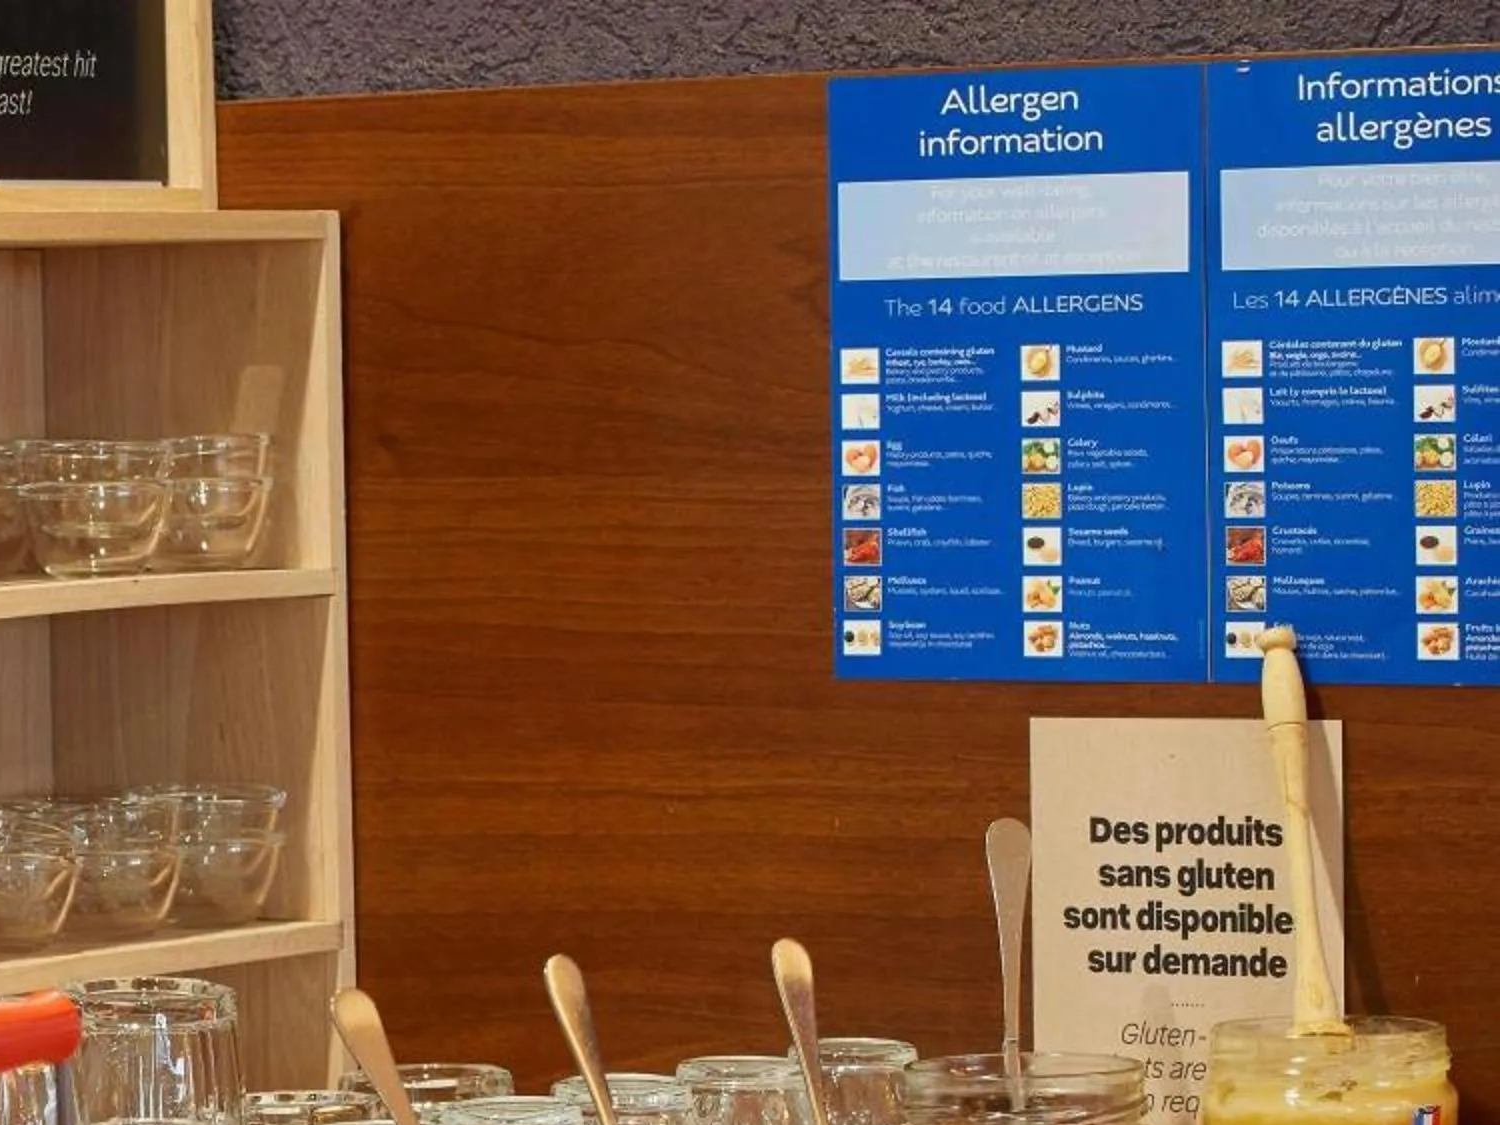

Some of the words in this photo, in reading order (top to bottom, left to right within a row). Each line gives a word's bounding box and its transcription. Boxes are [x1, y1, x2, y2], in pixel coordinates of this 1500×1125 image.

[71, 49, 97, 78] hit
[1297, 69, 1500, 101] Informations
[939, 83, 1079, 122] Allergen
[919, 124, 1105, 158] information
[1315, 111, 1493, 150] allergènes
[884, 297, 923, 318] The
[929, 297, 953, 316] 14
[959, 295, 1007, 317] food
[1011, 292, 1144, 313] ALLERGENS
[1233, 288, 1270, 310] Les
[1274, 288, 1301, 308] 14
[1304, 284, 1449, 308] ALLERGÈNES
[1088, 815, 1151, 845] Des
[1155, 815, 1284, 853] produits
[1098, 862, 1172, 890] sans
[1176, 857, 1276, 897] gluten
[1062, 903, 1132, 931] sont
[1135, 900, 1295, 941] disponible
[1087, 948, 1138, 974] sur
[1142, 943, 1289, 979] demande
[1120, 1019, 1208, 1049] Gluten-
[1168, 1060, 1209, 1082] are
